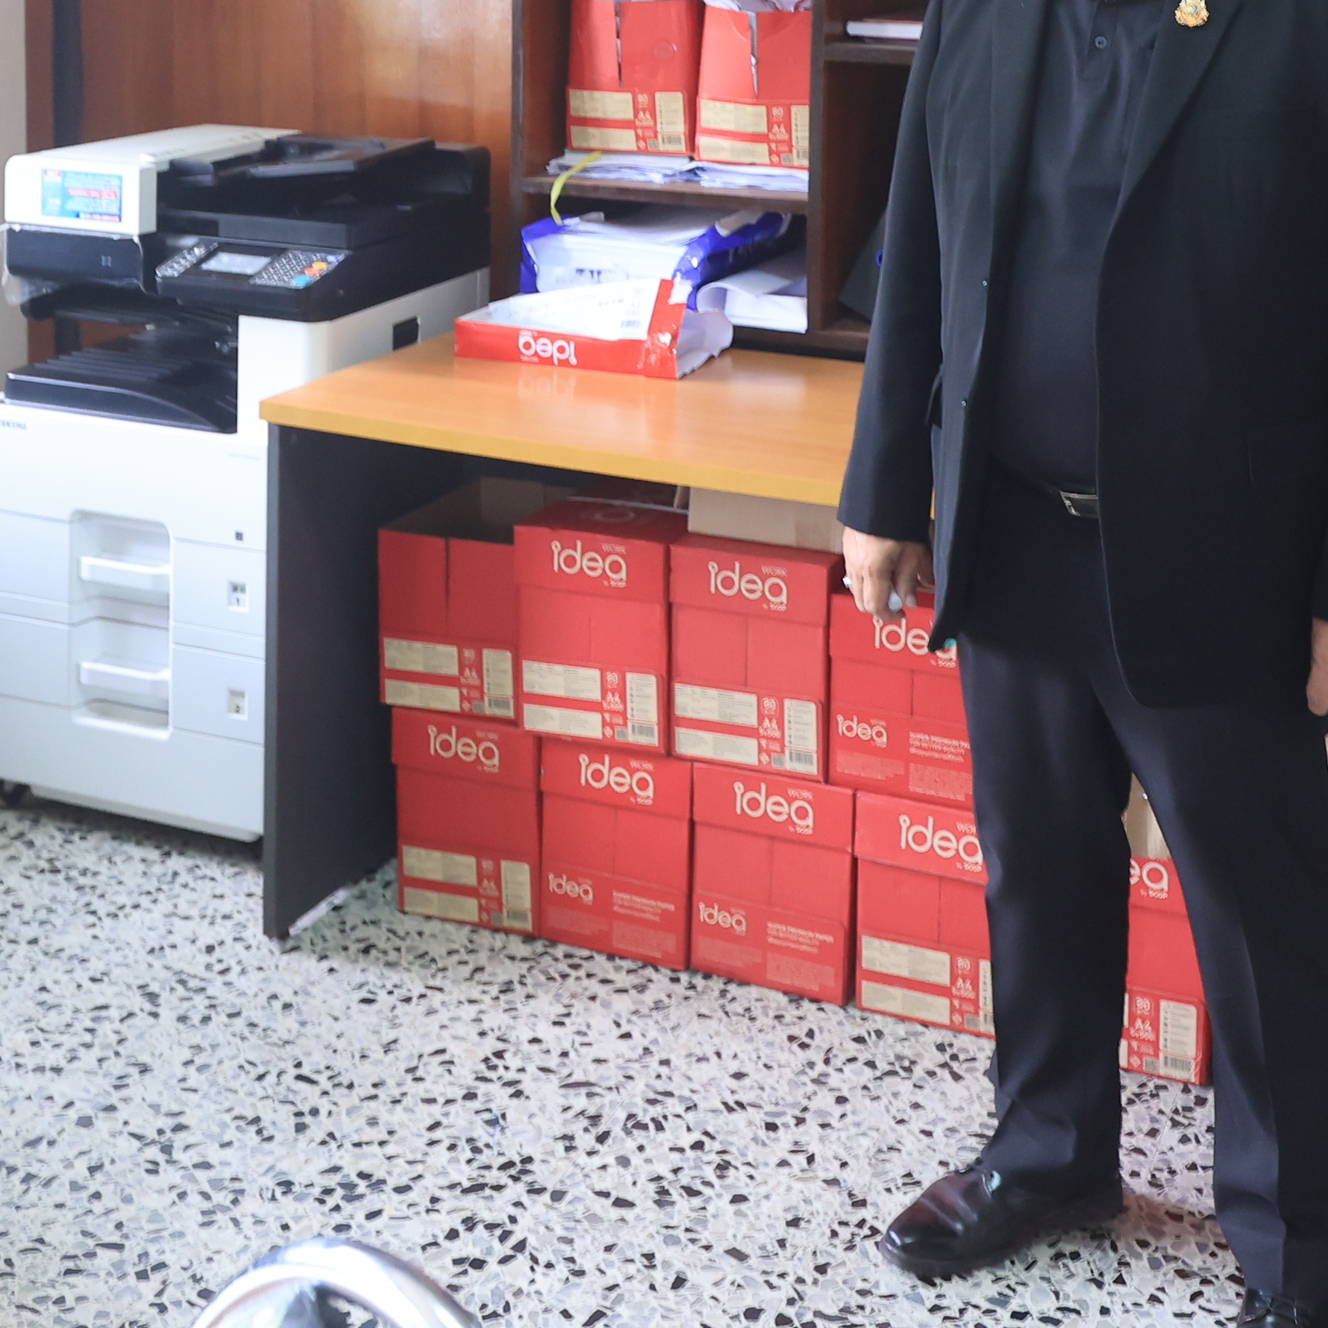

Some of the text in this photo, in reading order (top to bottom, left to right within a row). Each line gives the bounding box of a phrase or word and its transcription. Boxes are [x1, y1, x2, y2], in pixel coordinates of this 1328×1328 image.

[518, 335, 578, 366] idea
[552, 540, 627, 580] idea
[761, 565, 787, 577] WORK
[708, 561, 787, 604] idea
[837, 714, 887, 744] idea
[428, 725, 499, 767] idea
[579, 754, 654, 799] idea
[629, 759, 654, 772] WORK
[733, 781, 814, 829] idea
[787, 788, 814, 801] WORK
[899, 814, 983, 865] idea
[548, 873, 594, 902] idea
[698, 901, 747, 931] idea
[1135, 1017, 1152, 1033] A4
